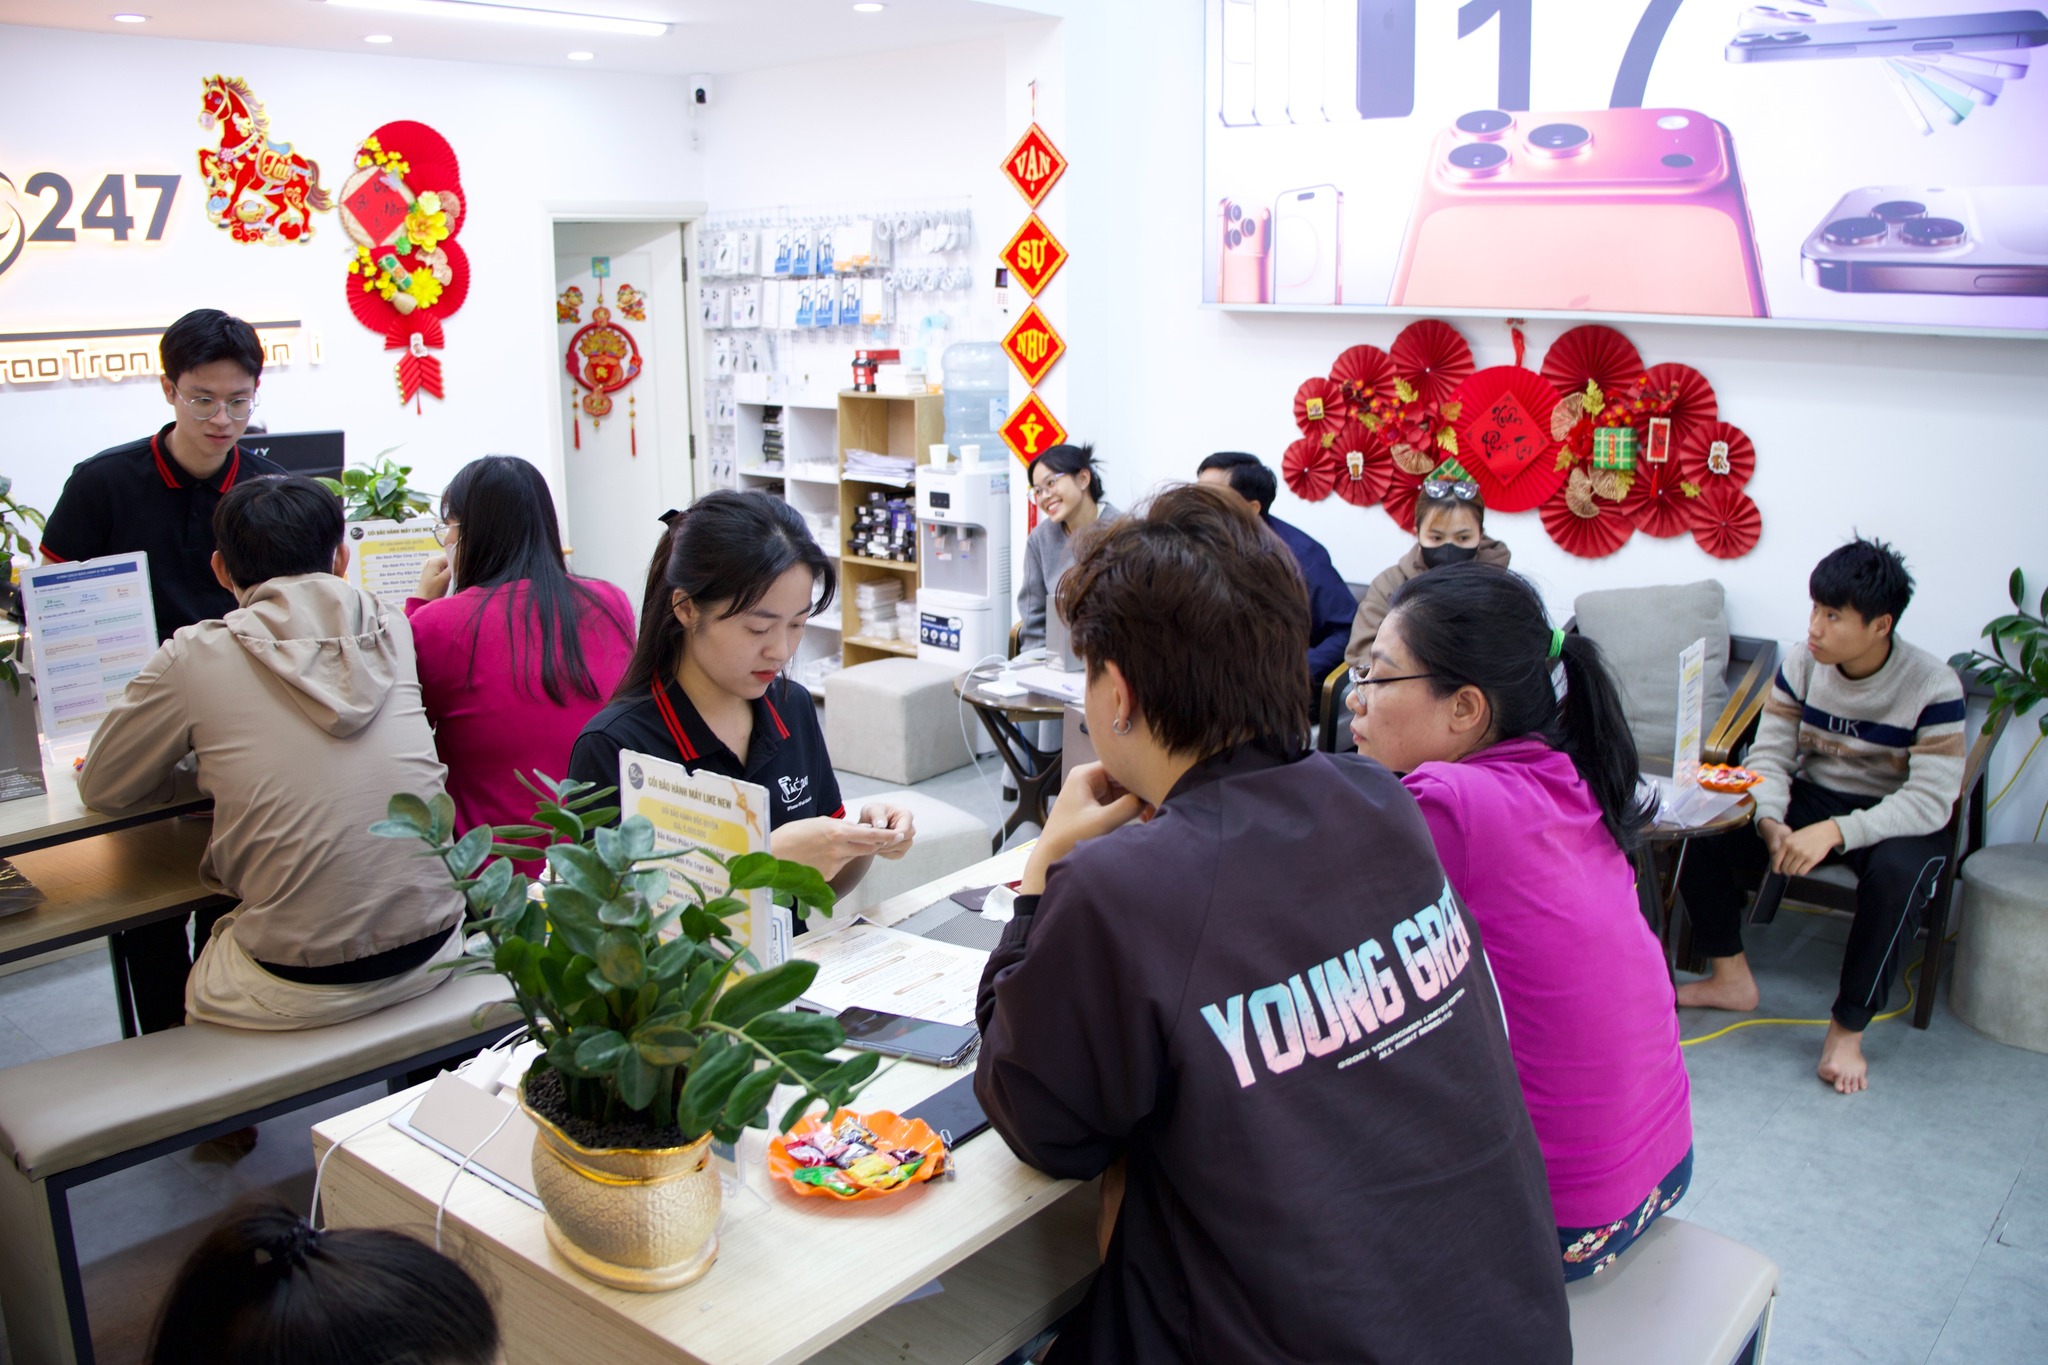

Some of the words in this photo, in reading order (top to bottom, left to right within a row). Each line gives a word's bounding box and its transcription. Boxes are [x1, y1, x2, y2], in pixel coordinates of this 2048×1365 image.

[1014, 144, 1051, 192] VẠN
[24, 171, 182, 242] 247
[1017, 237, 1048, 276] SỰ
[1016, 328, 1050, 364] NHƯ
[1019, 412, 1044, 454] Ý
[1828, 714, 1860, 738] UK
[703, 793, 717, 806] LIKE
[717, 797, 732, 810] NEW
[1200, 938, 1405, 1088] YOUNG
